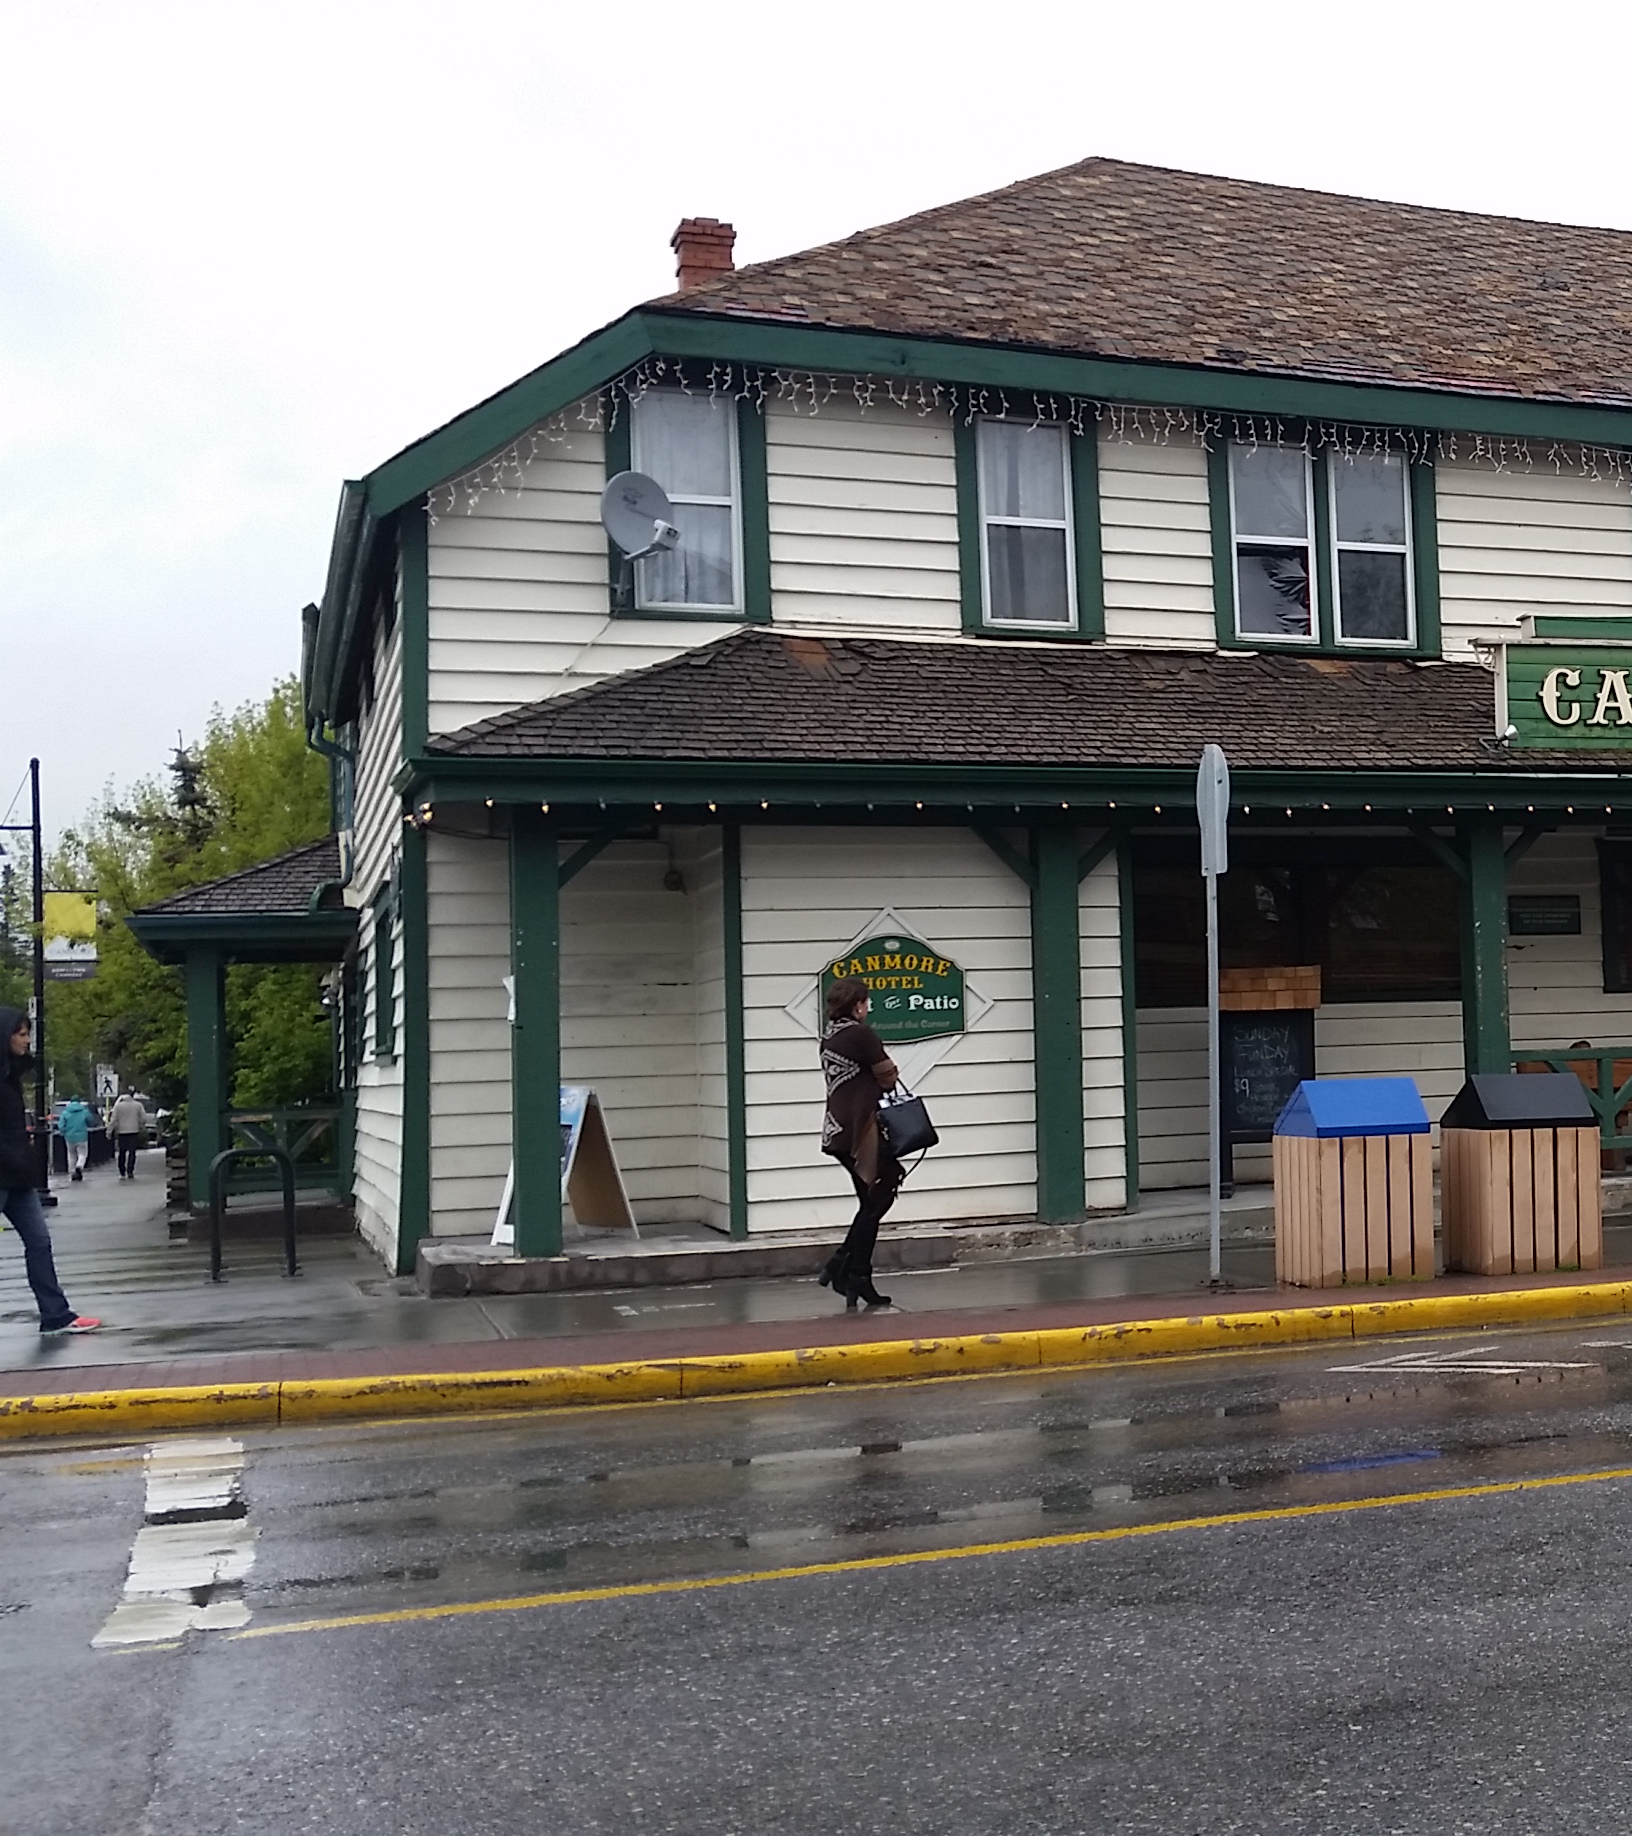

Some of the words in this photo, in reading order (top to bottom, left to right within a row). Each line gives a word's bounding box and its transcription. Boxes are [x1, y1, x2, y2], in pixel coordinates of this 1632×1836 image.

[831, 953, 952, 979] CANMORE
[862, 976, 924, 990] HOTEL
[908, 994, 960, 1011] Patio
[920, 1019, 951, 1028] Corner
[1233, 1024, 1290, 1043] SUNDAY
[1238, 1044, 1289, 1064] FUNDAY
